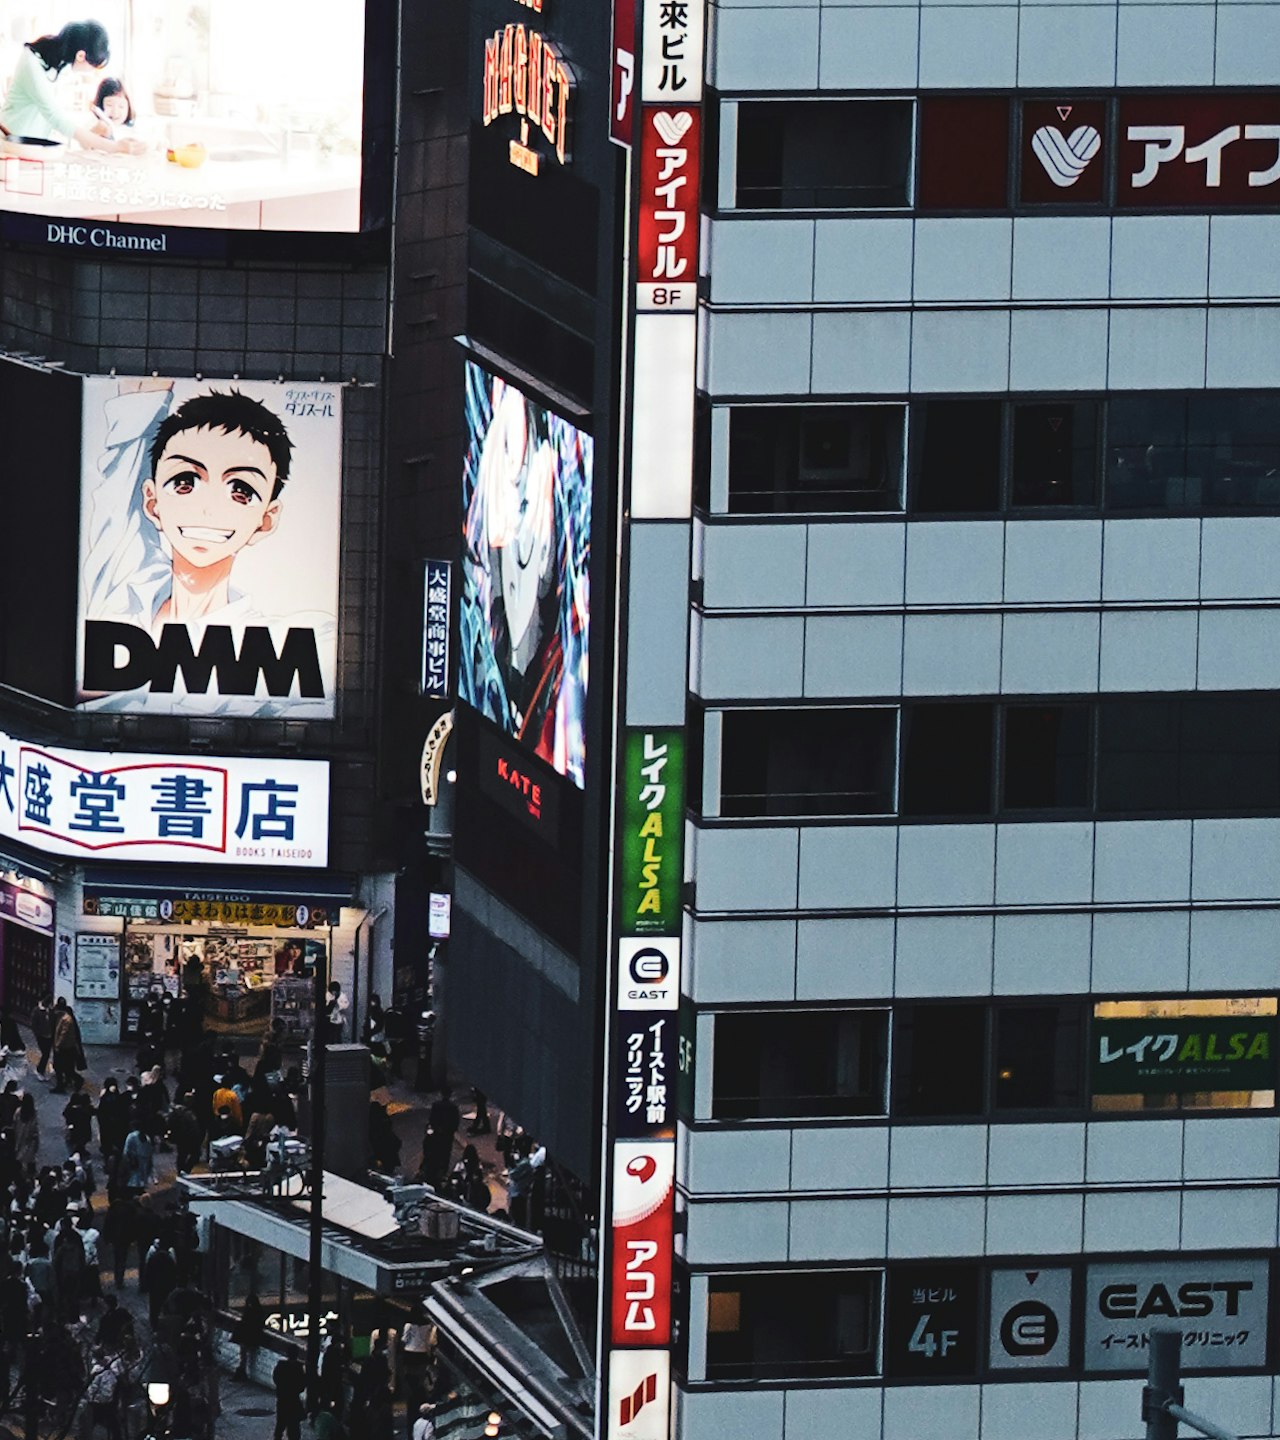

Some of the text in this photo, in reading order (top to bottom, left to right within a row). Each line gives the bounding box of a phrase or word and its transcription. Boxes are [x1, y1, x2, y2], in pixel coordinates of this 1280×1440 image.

[483, 23, 570, 166] MAGNET
[46, 224, 167, 253] DHC Channel
[652, 148, 688, 280] アイフル
[651, 287, 682, 306] 8F
[81, 618, 326, 700] DMM
[425, 568, 448, 691] 大盛堂商事ビル
[497, 757, 542, 807] KATE
[637, 732, 669, 812] レイク
[235, 846, 314, 860] BOOKS TAISEIDO
[636, 811, 664, 916] ALSA
[184, 892, 251, 904] TAISEIDO
[625, 1031, 645, 1114] クリニック
[645, 1018, 668, 1125] イースト駅前
[679, 1035, 693, 1076] 5F
[623, 1239, 659, 1332] アコム
[912, 1287, 958, 1304] 当ビル
[907, 1312, 959, 1358] 4F
